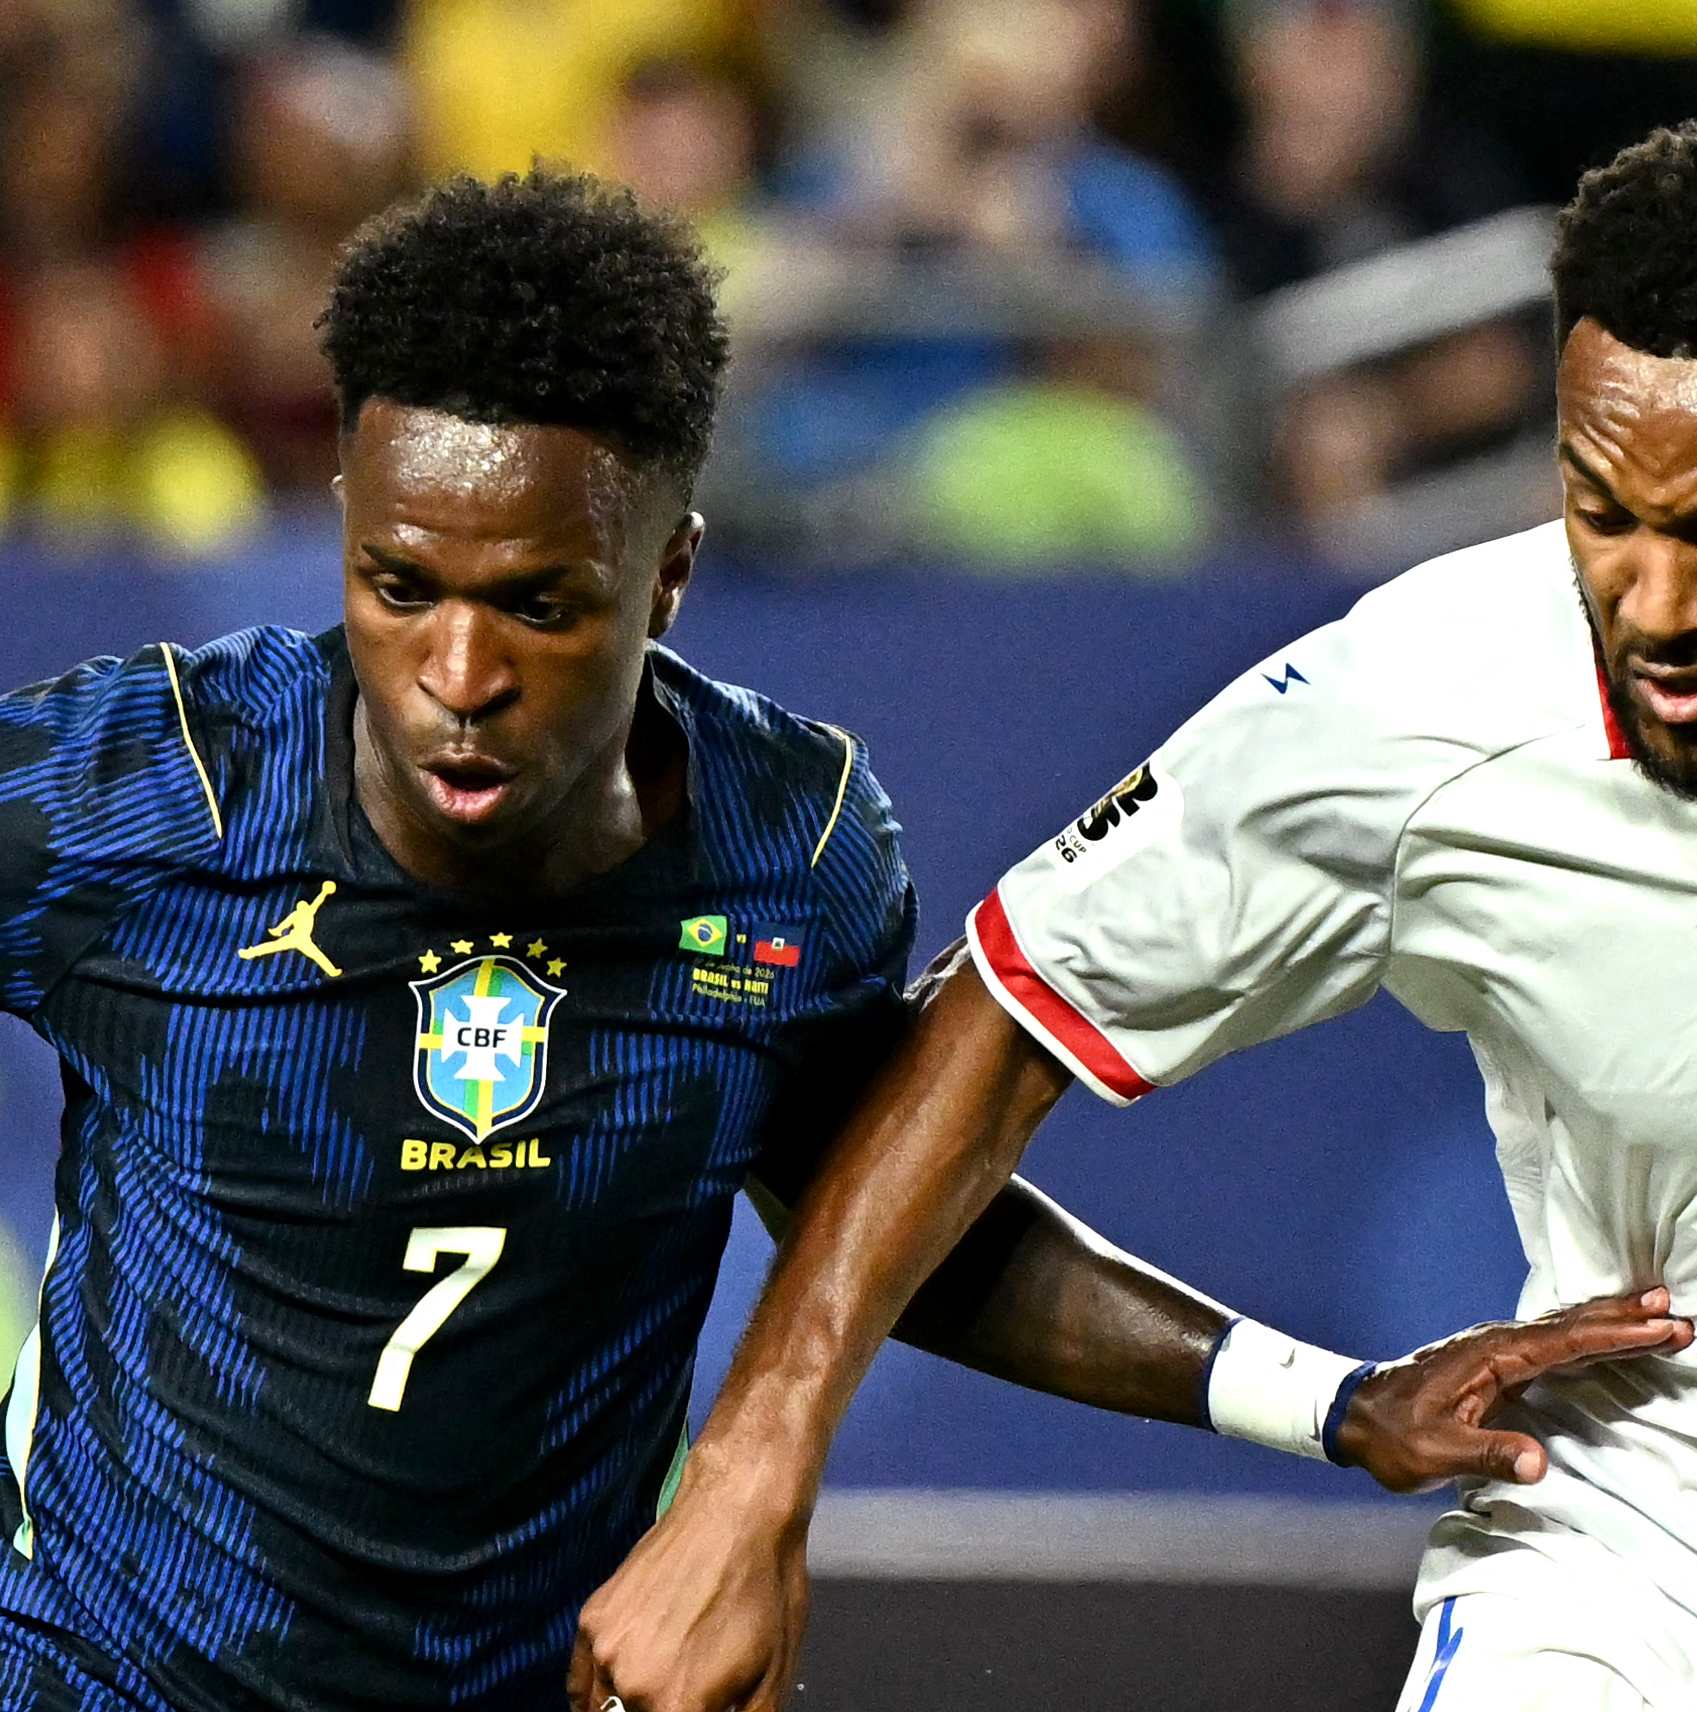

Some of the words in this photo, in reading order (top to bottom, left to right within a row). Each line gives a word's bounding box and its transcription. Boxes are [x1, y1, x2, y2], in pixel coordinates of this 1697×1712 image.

[1055, 834, 1078, 864] 26
[692, 967, 729, 988] BRASIL
[456, 1026, 507, 1049] CBF
[400, 1138, 551, 1171] BRASIL
[368, 1226, 507, 1412] 7
